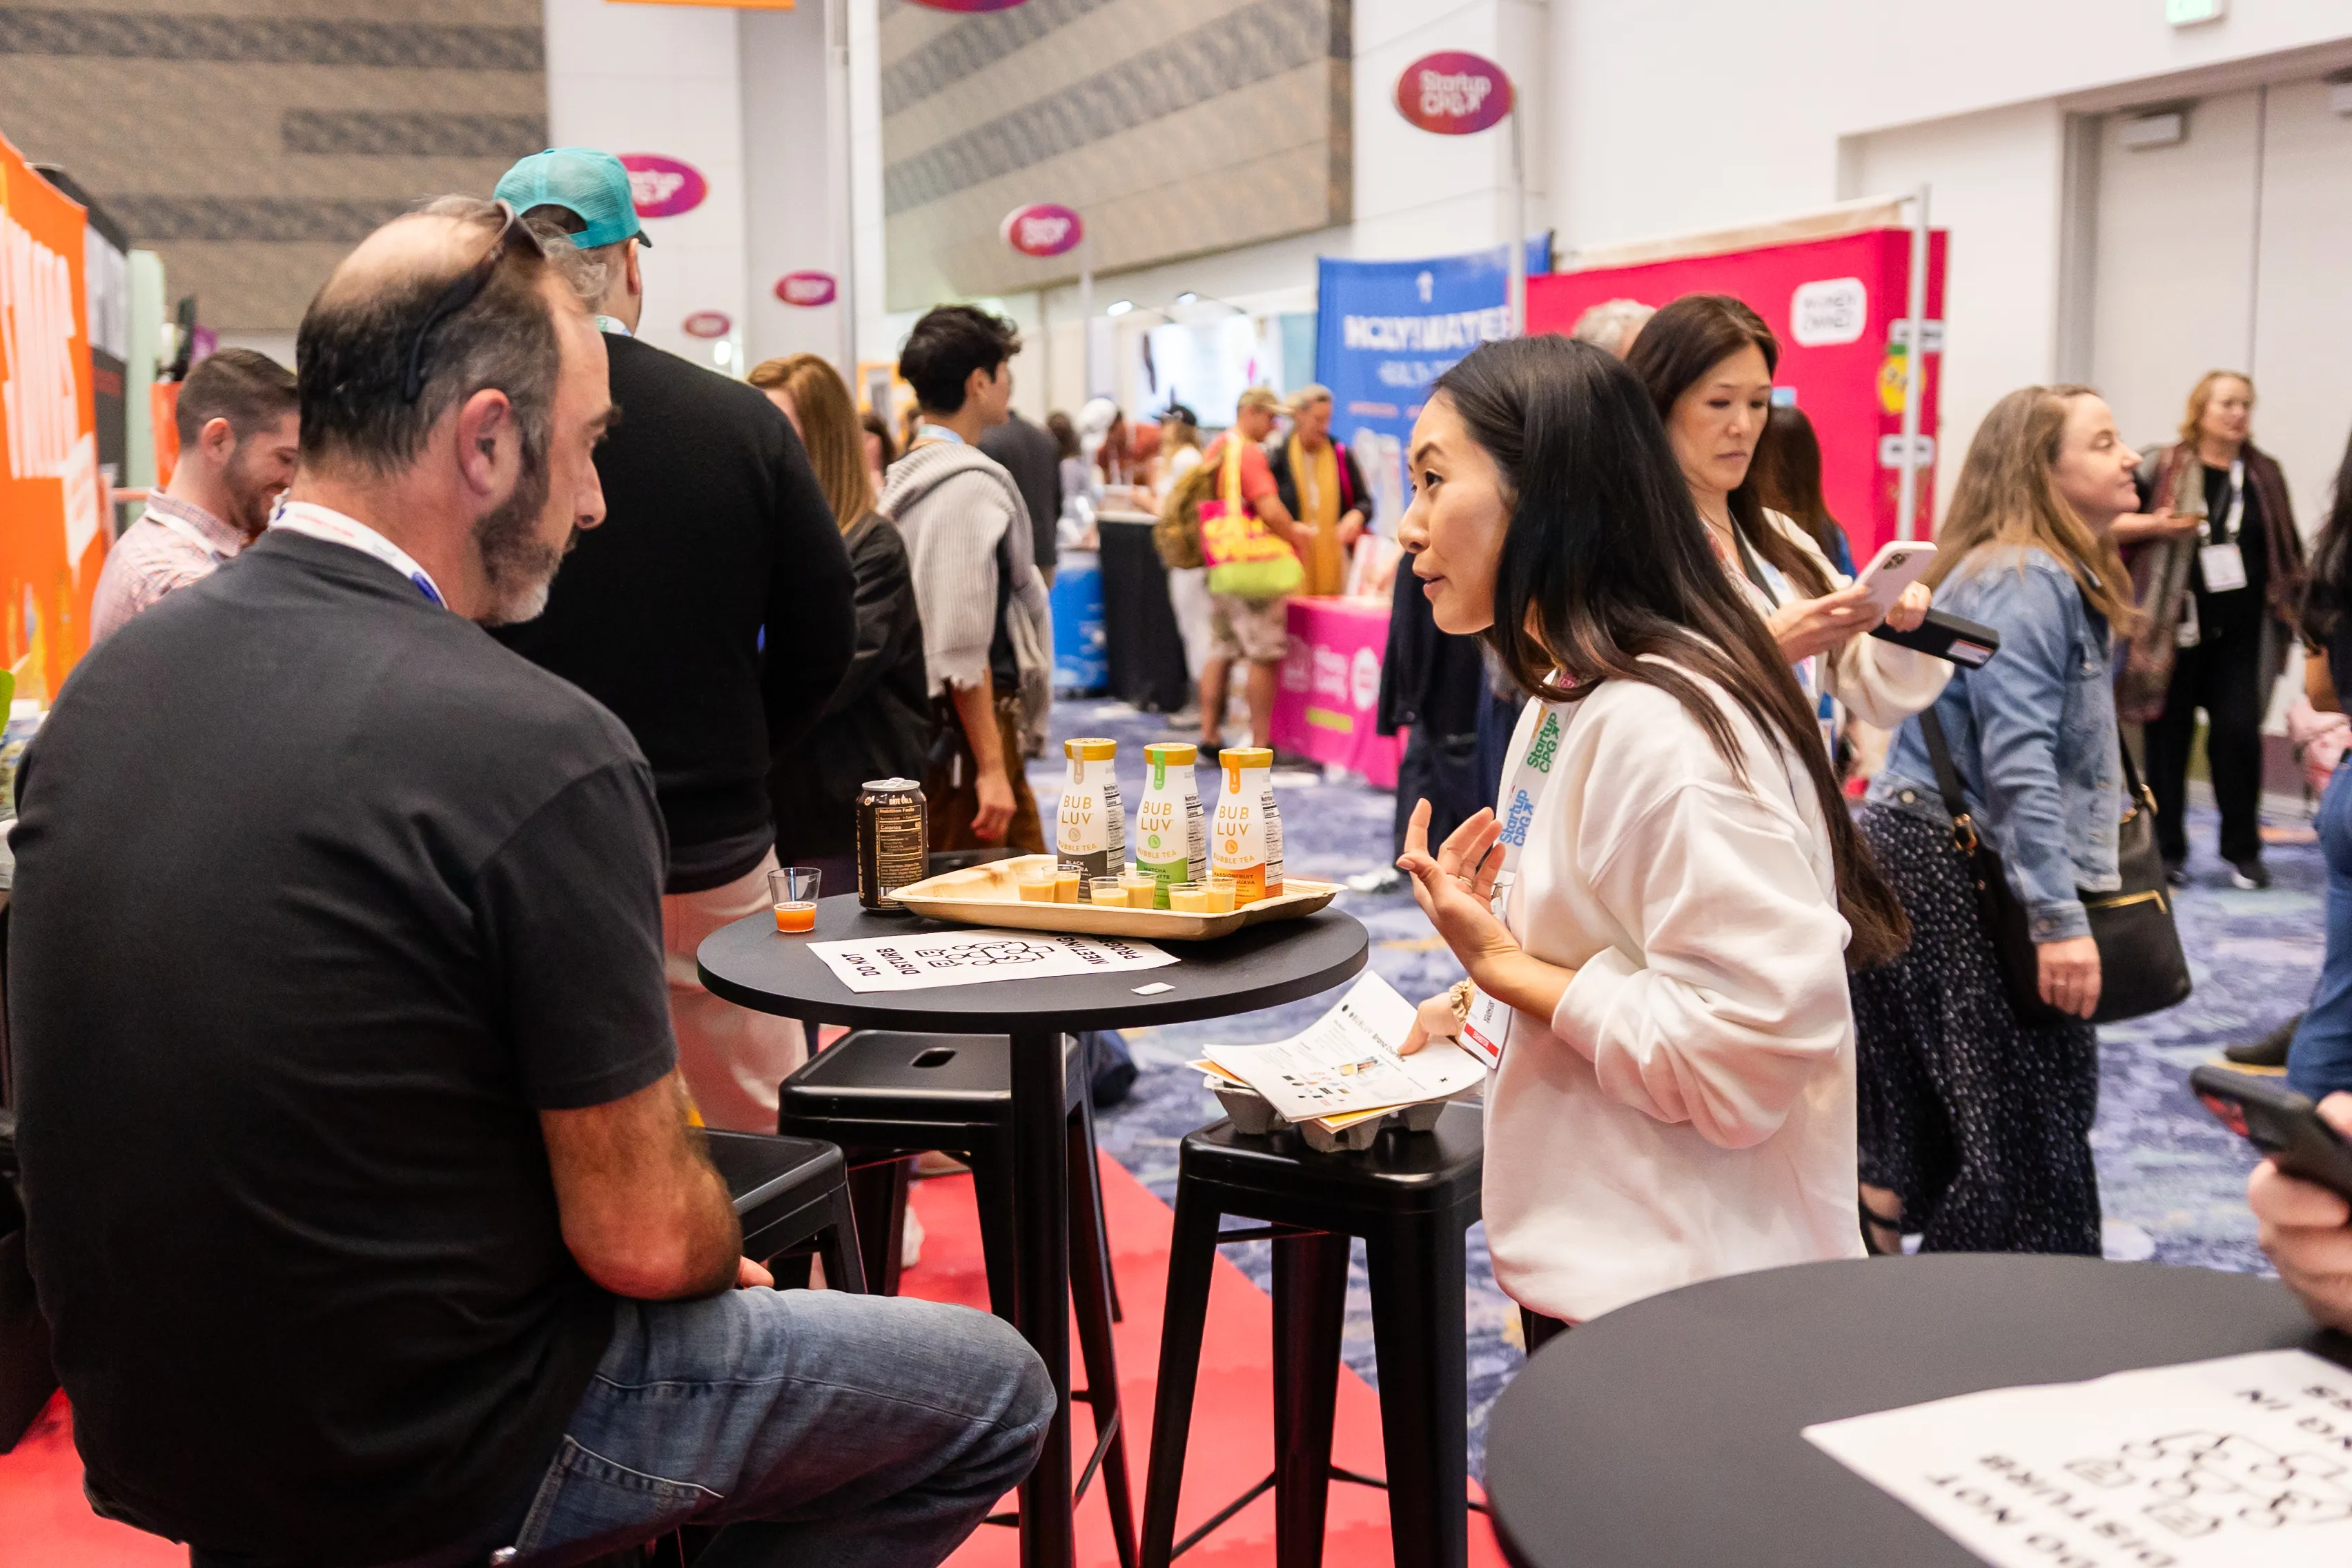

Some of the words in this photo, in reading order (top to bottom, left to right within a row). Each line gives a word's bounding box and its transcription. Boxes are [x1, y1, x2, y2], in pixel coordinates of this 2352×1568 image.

[1527, 712, 1558, 768] Startup
[1538, 739, 1558, 774] CPG
[1064, 795, 1092, 810] BUB
[1143, 801, 1172, 816] BUB
[1061, 811, 1091, 825] LUV
[1219, 805, 1249, 821] BUB
[1500, 789, 1528, 844] Startup
[1141, 817, 1171, 832] LUV
[1217, 822, 1248, 836] LUV
[1513, 814, 1533, 847] CPG
[1162, 850, 1177, 858] TEA
[1213, 852, 1237, 864] BUBBLE
[1239, 855, 1255, 863] TEA
[1056, 937, 1110, 965] MEETING
[841, 954, 870, 965] NOT
[876, 948, 921, 974] DISTURB
[856, 966, 881, 976] DO
